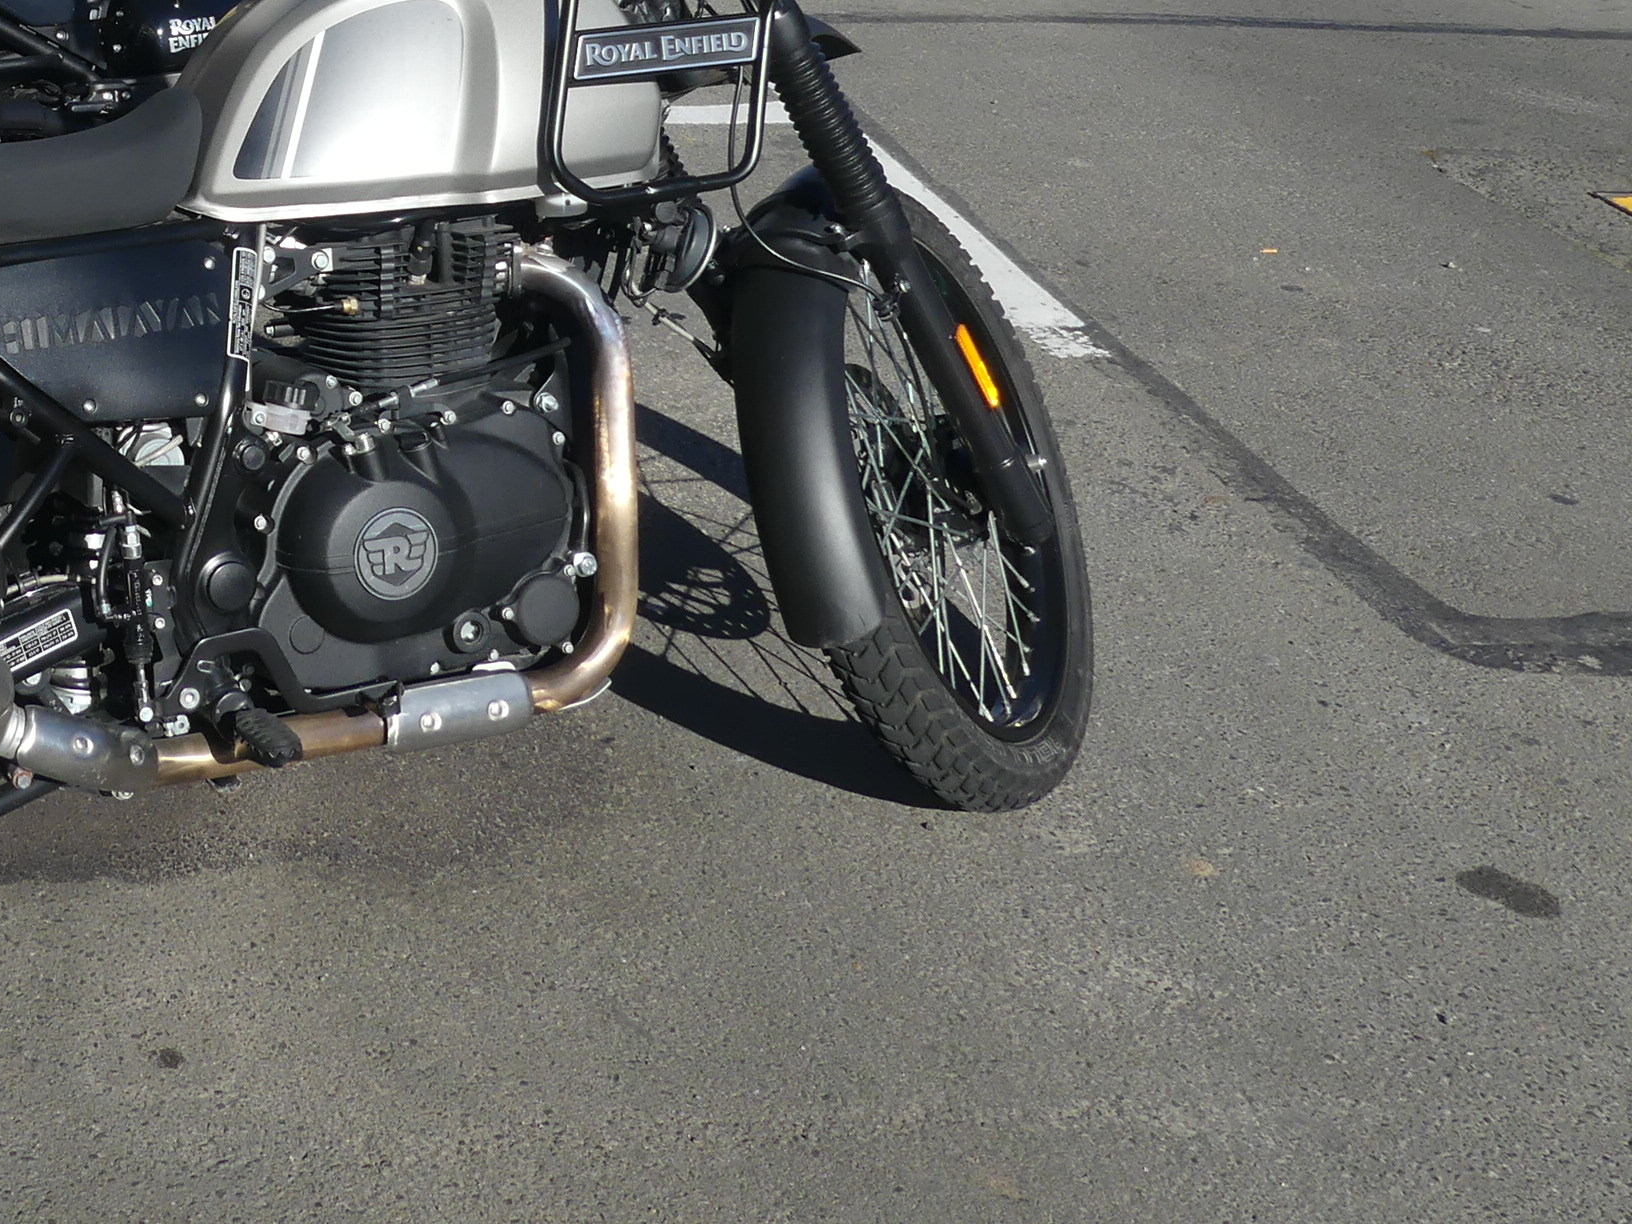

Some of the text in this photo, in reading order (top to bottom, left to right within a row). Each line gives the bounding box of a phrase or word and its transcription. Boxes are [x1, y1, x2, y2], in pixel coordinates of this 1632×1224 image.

[169, 16, 216, 36] ROYAL
[586, 31, 748, 67] ROYAL ENFIELD
[2, 290, 221, 356] HIMALAYAN
